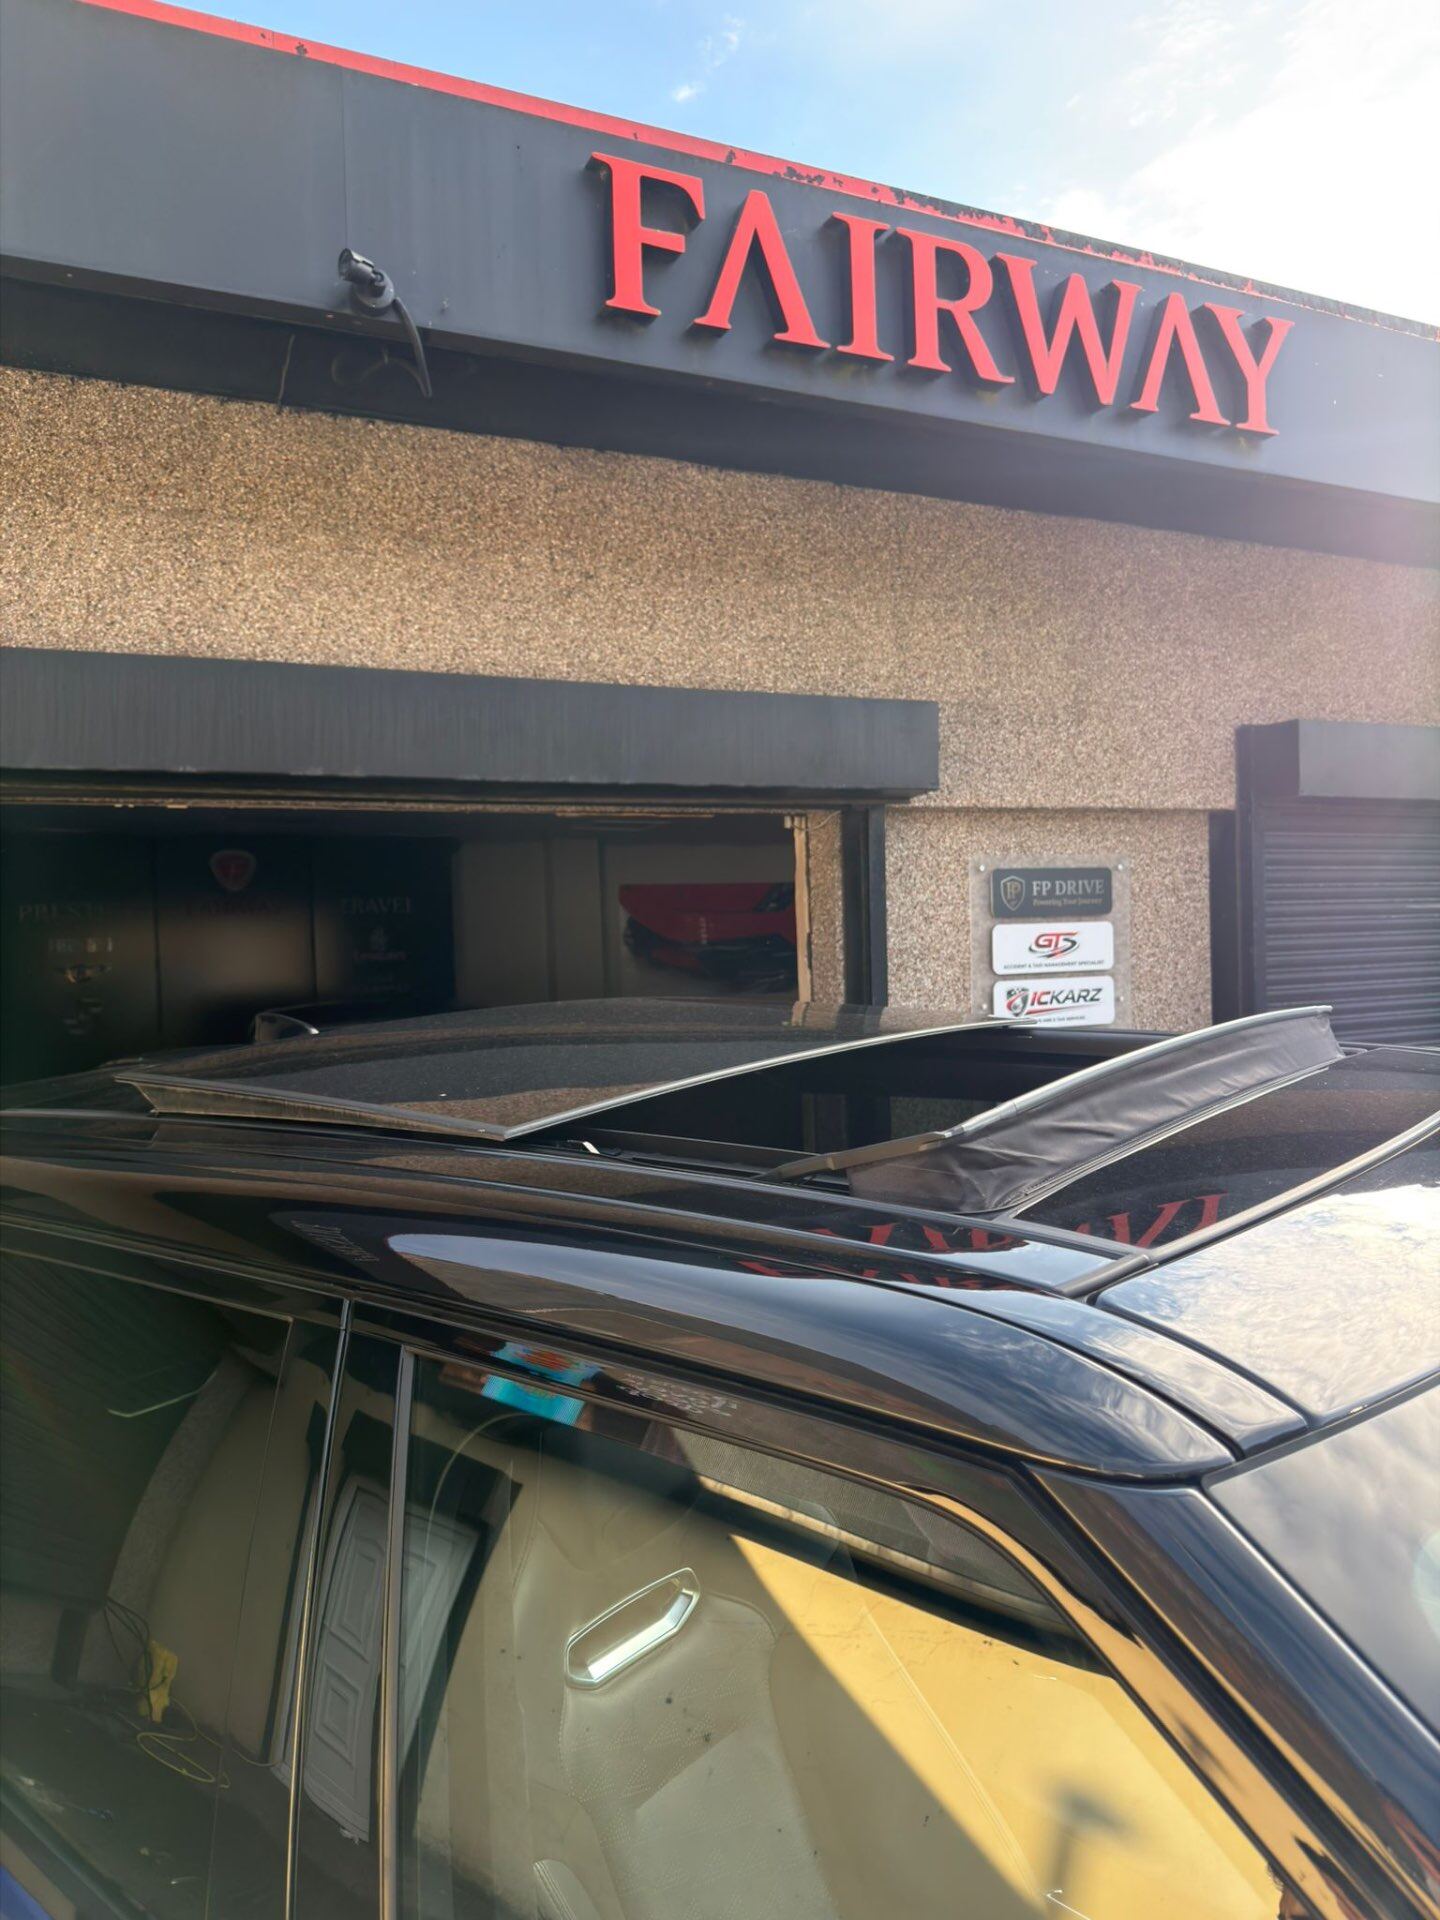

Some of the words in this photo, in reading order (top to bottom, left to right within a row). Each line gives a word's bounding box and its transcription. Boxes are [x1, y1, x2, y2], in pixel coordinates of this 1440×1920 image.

[590, 151, 1296, 437] FAIRWAY
[1032, 880, 1051, 896] FP
[1055, 879, 1105, 896] DRIVE
[1031, 931, 1079, 958] GTS
[1030, 988, 1103, 1006] ICKARZ
